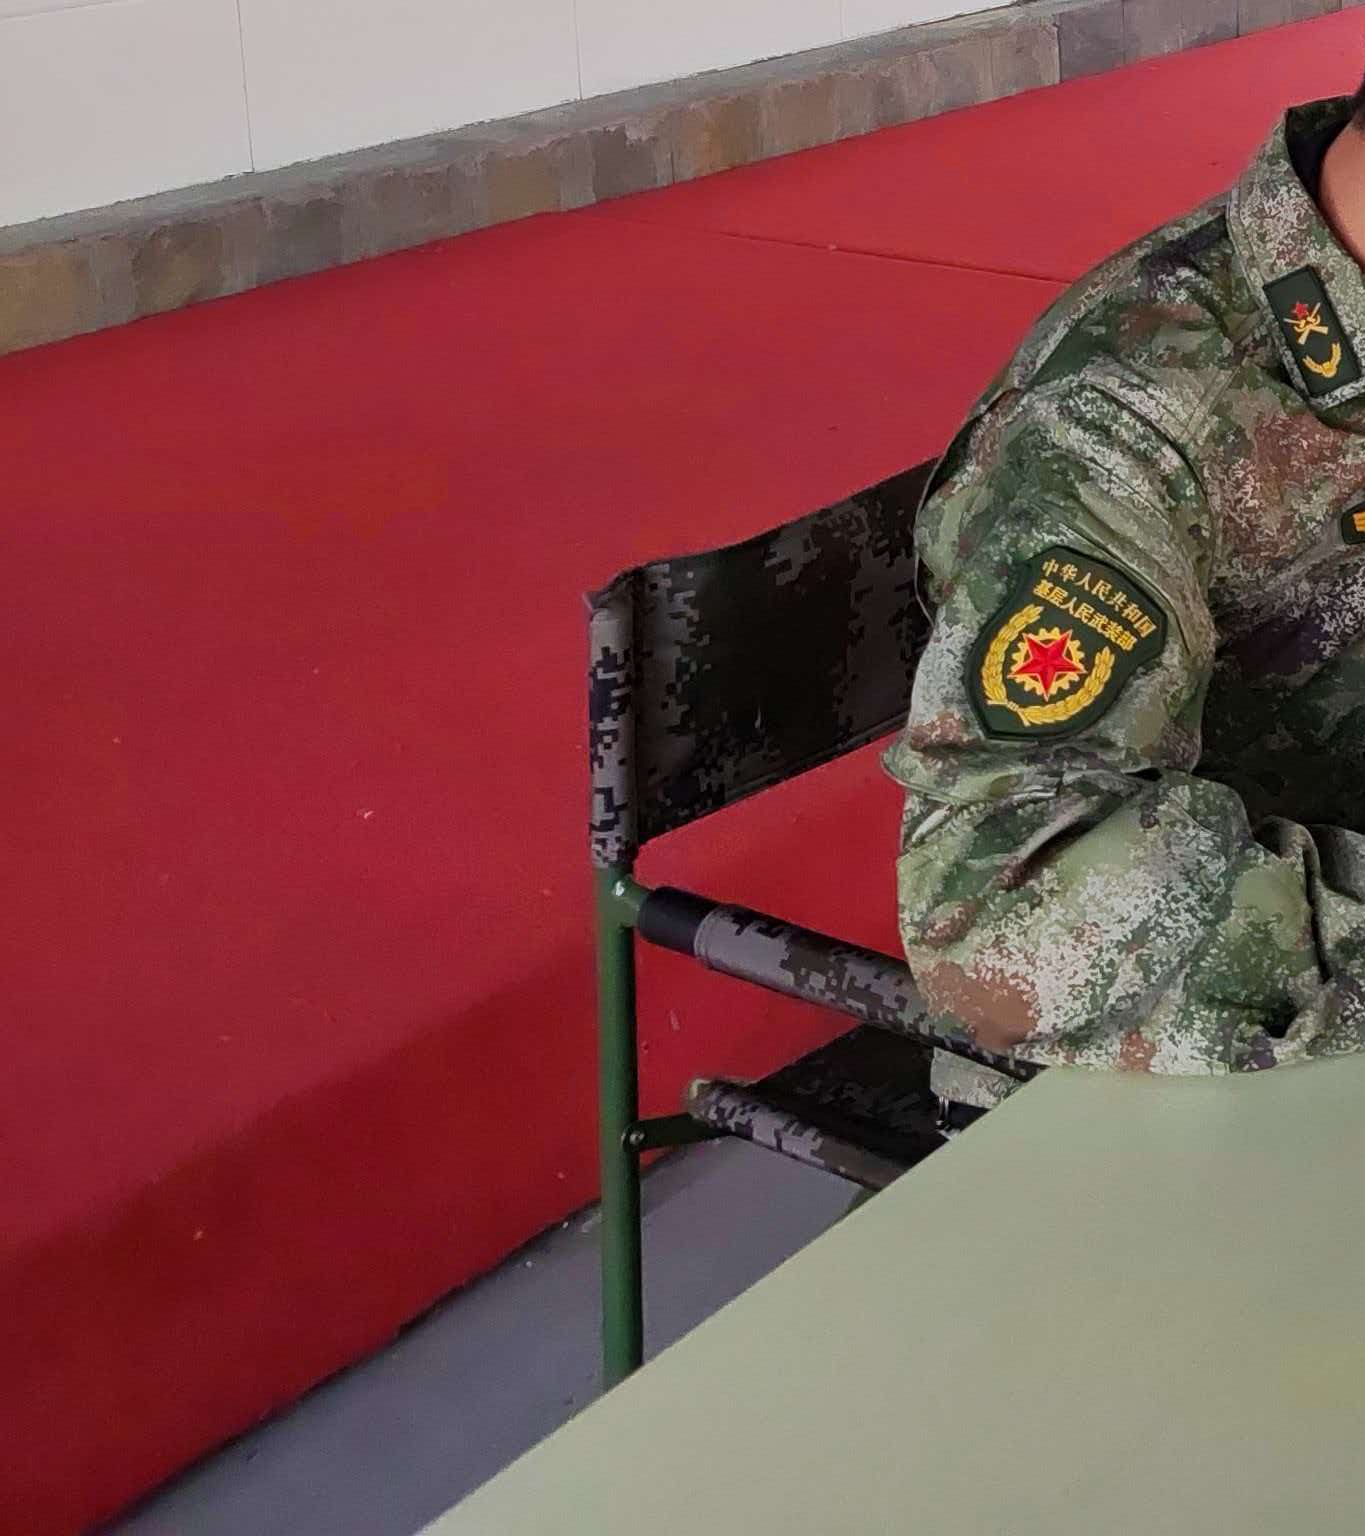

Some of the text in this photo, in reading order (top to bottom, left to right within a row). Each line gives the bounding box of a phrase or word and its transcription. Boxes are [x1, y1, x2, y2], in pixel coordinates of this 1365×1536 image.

[1033, 579, 1138, 652] 基层人民武装部
[1042, 559, 1157, 638] 中华人民共和国
